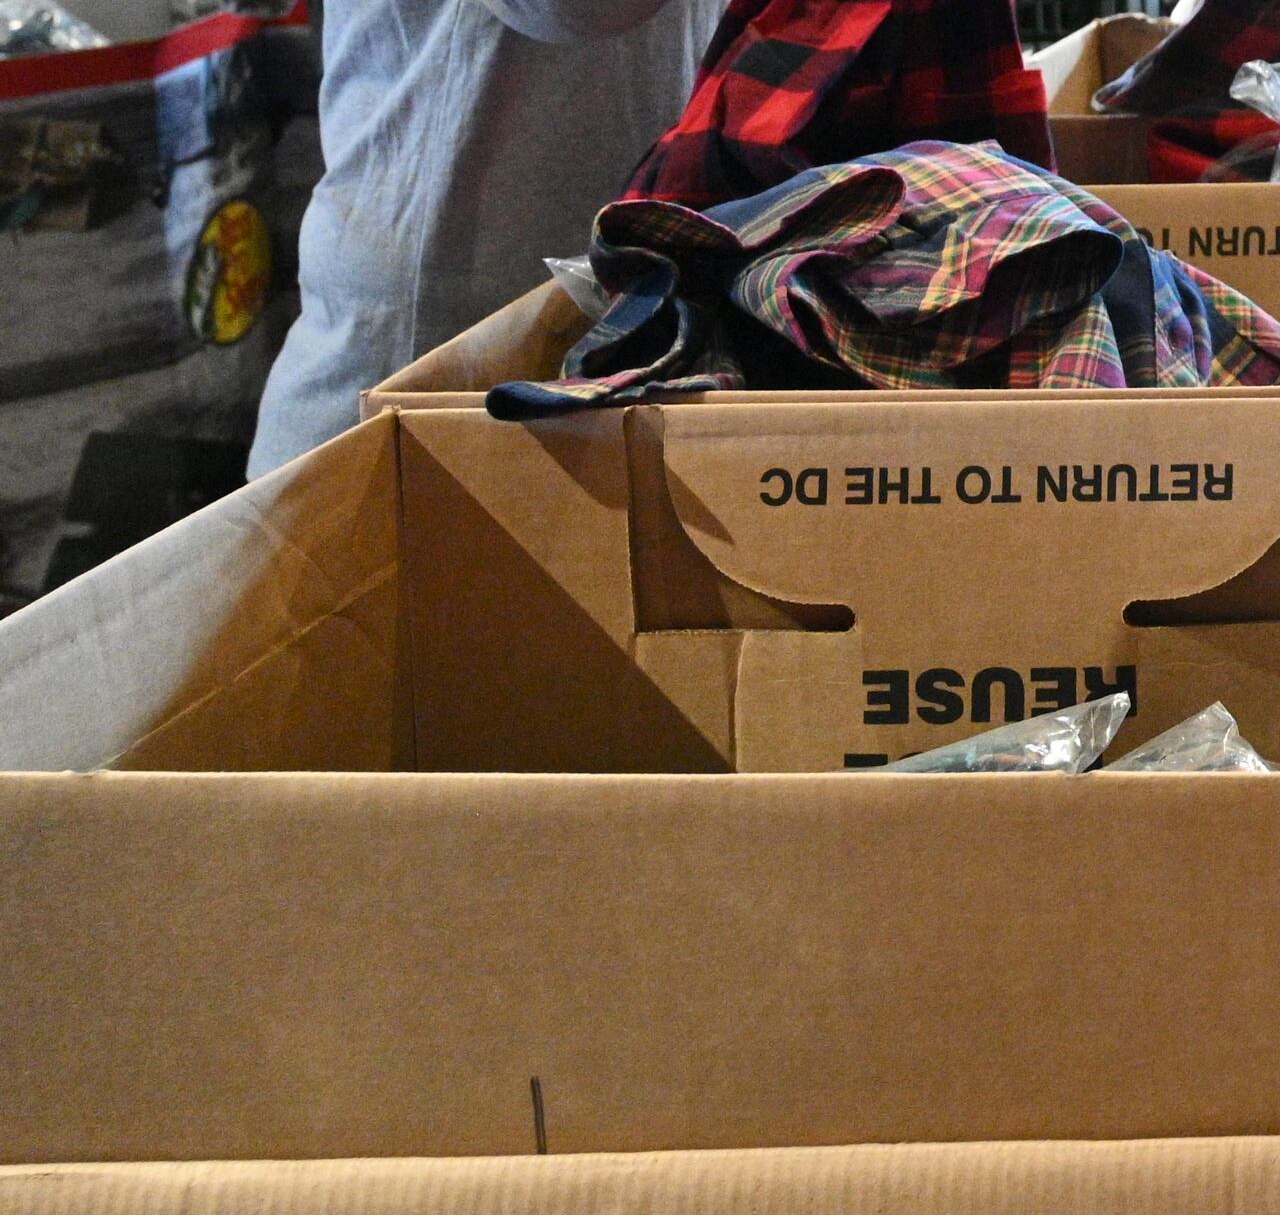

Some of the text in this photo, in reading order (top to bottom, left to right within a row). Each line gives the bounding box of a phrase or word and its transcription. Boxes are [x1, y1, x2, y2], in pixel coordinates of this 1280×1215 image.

[759, 463, 1233, 507] RETURN TO THE DC
[861, 665, 1137, 725] REUSE
